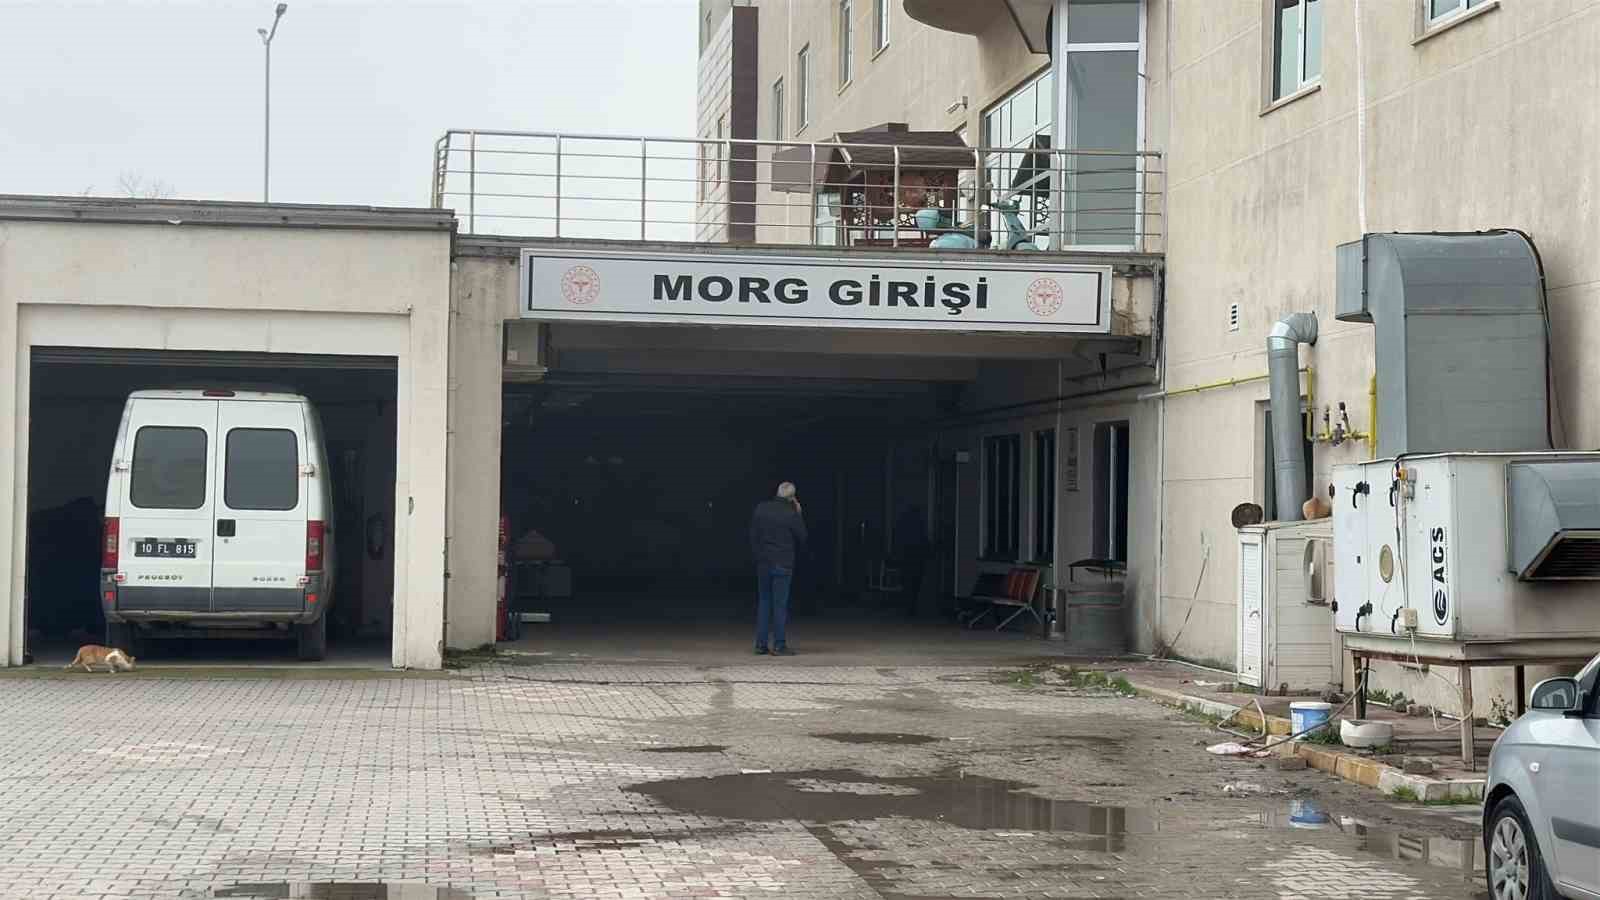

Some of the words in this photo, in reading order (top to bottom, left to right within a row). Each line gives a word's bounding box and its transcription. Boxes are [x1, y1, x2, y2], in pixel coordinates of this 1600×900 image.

[653, 274, 809, 305] MORG
[828, 274, 988, 315] GİRİŞİ
[142, 543, 153, 553] 10
[157, 543, 169, 554] FL
[175, 544, 194, 554] 815
[1431, 527, 1445, 584] ACS
